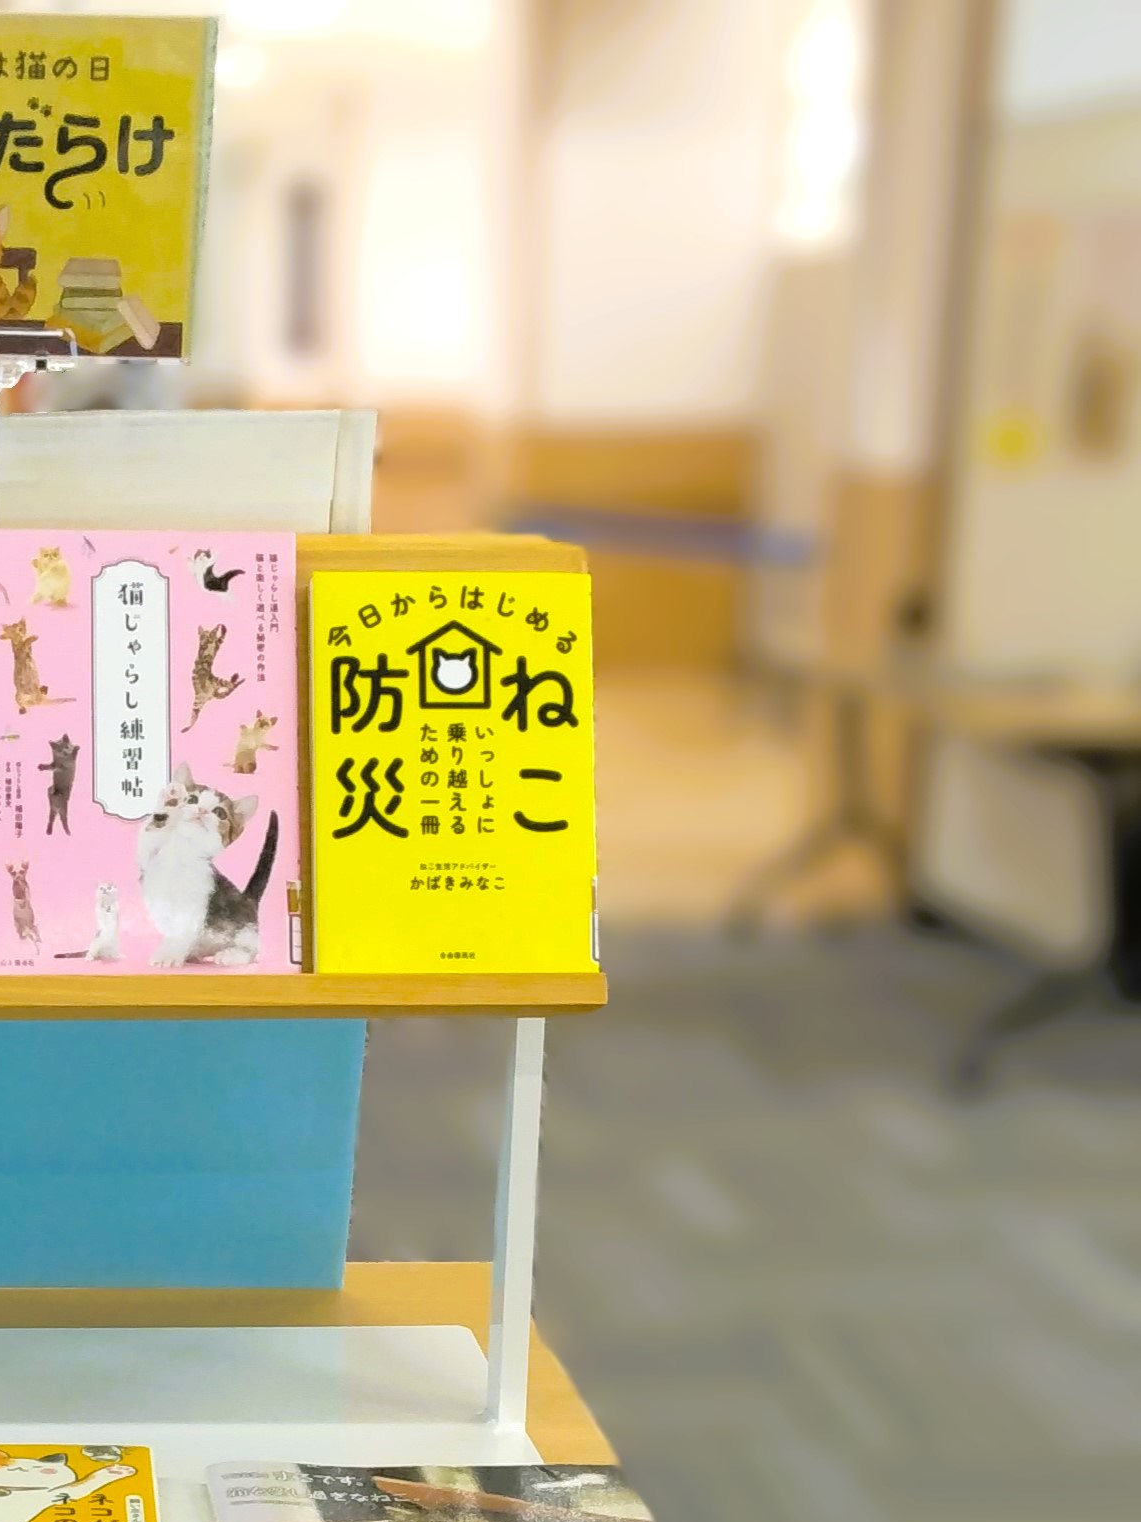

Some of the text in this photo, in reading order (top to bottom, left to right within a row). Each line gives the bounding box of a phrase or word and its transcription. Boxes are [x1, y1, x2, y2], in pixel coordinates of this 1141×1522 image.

[327, 585, 578, 655] 今日からはじめる
[118, 582, 145, 798] 猫じゃらし練習帖
[501, 655, 579, 833] ねこ
[330, 653, 410, 840] 防災
[420, 723, 441, 835] ための一冊
[447, 722, 469, 835] 乗り越える
[476, 725, 496, 834] いっしょに
[409, 875, 505, 891] かばきみなこ
